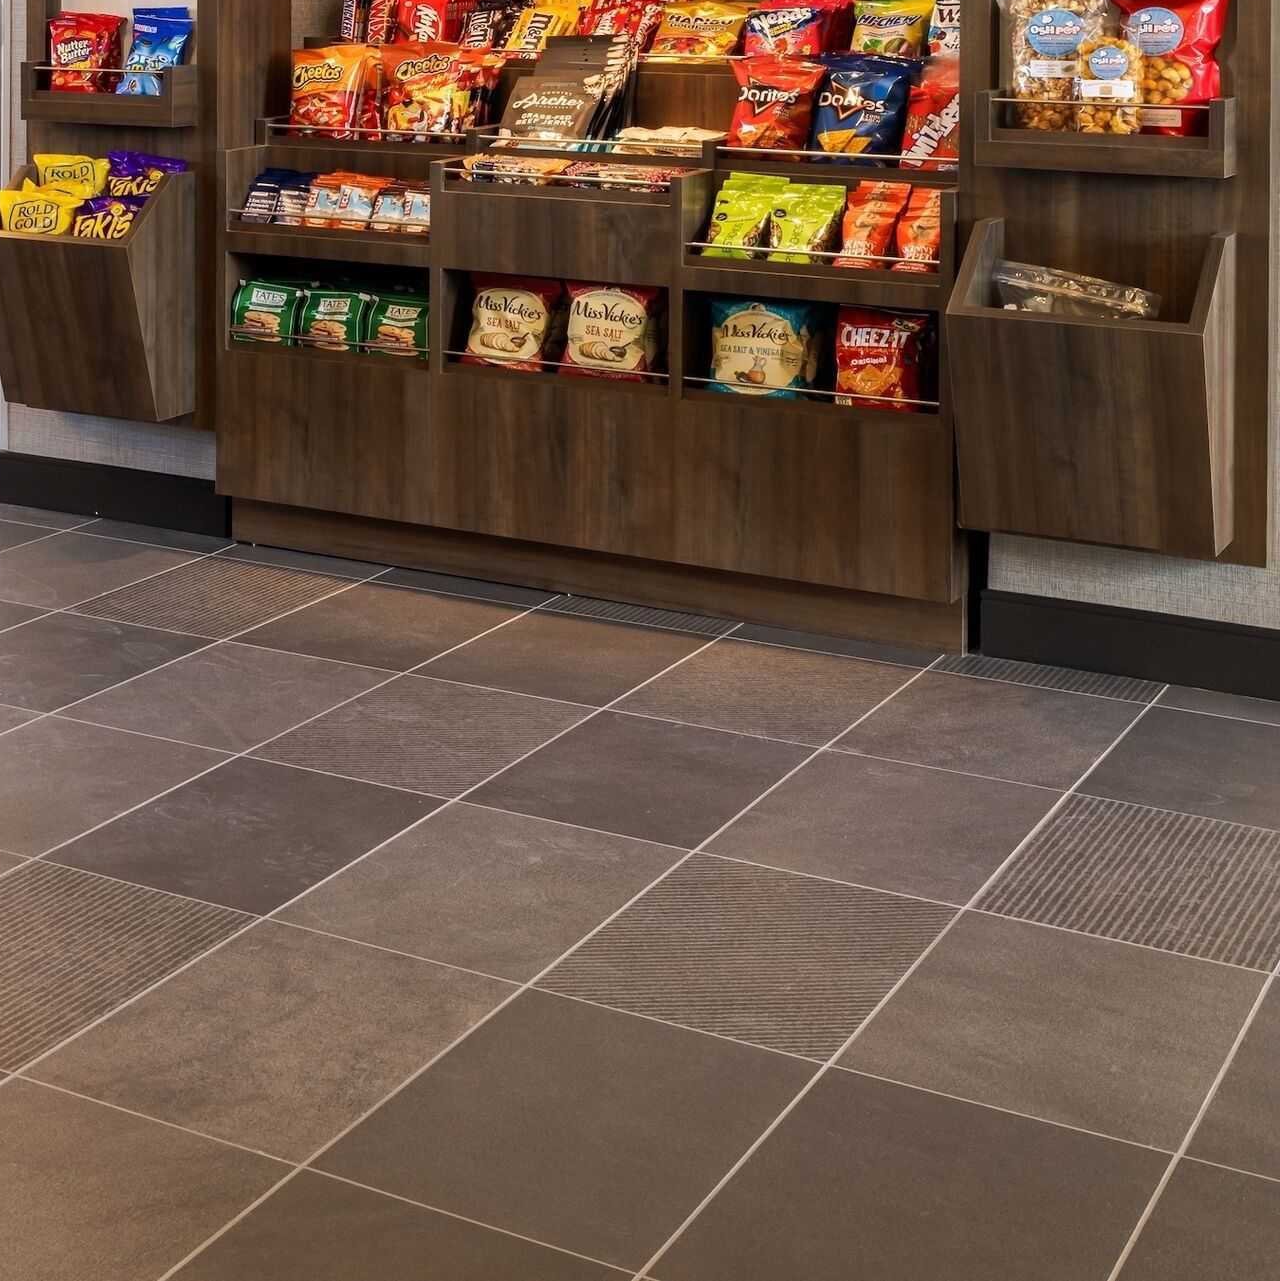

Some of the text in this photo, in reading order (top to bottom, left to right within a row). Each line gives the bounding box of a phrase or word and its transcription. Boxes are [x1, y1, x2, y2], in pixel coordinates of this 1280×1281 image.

[856, 13, 922, 27] HI-CHEW
[56, 39, 90, 55] Nutter
[60, 47, 92, 64] Butter
[396, 54, 450, 81] Cheetos
[293, 63, 343, 89] Cheetos
[512, 92, 584, 110] Archer
[739, 87, 799, 103] Doritos
[51, 165, 90, 178] ROLD
[18, 204, 54, 217] ROLD
[15, 216, 53, 229] GOLD
[255, 290, 285, 302] TATE'S
[322, 300, 348, 310] TATE'S
[390, 306, 418, 317] TATE'S
[477, 295, 544, 322] Miss Vickie's
[572, 300, 644, 329] Miss Vickie's
[487, 317, 521, 331] SEA SALT
[585, 324, 624, 340] SEA SALT
[720, 322, 791, 345] Miss Vickie's
[840, 326, 911, 349] CHEEZ-IT
[720, 344, 785, 357] SEA SALT & VINEGAR
